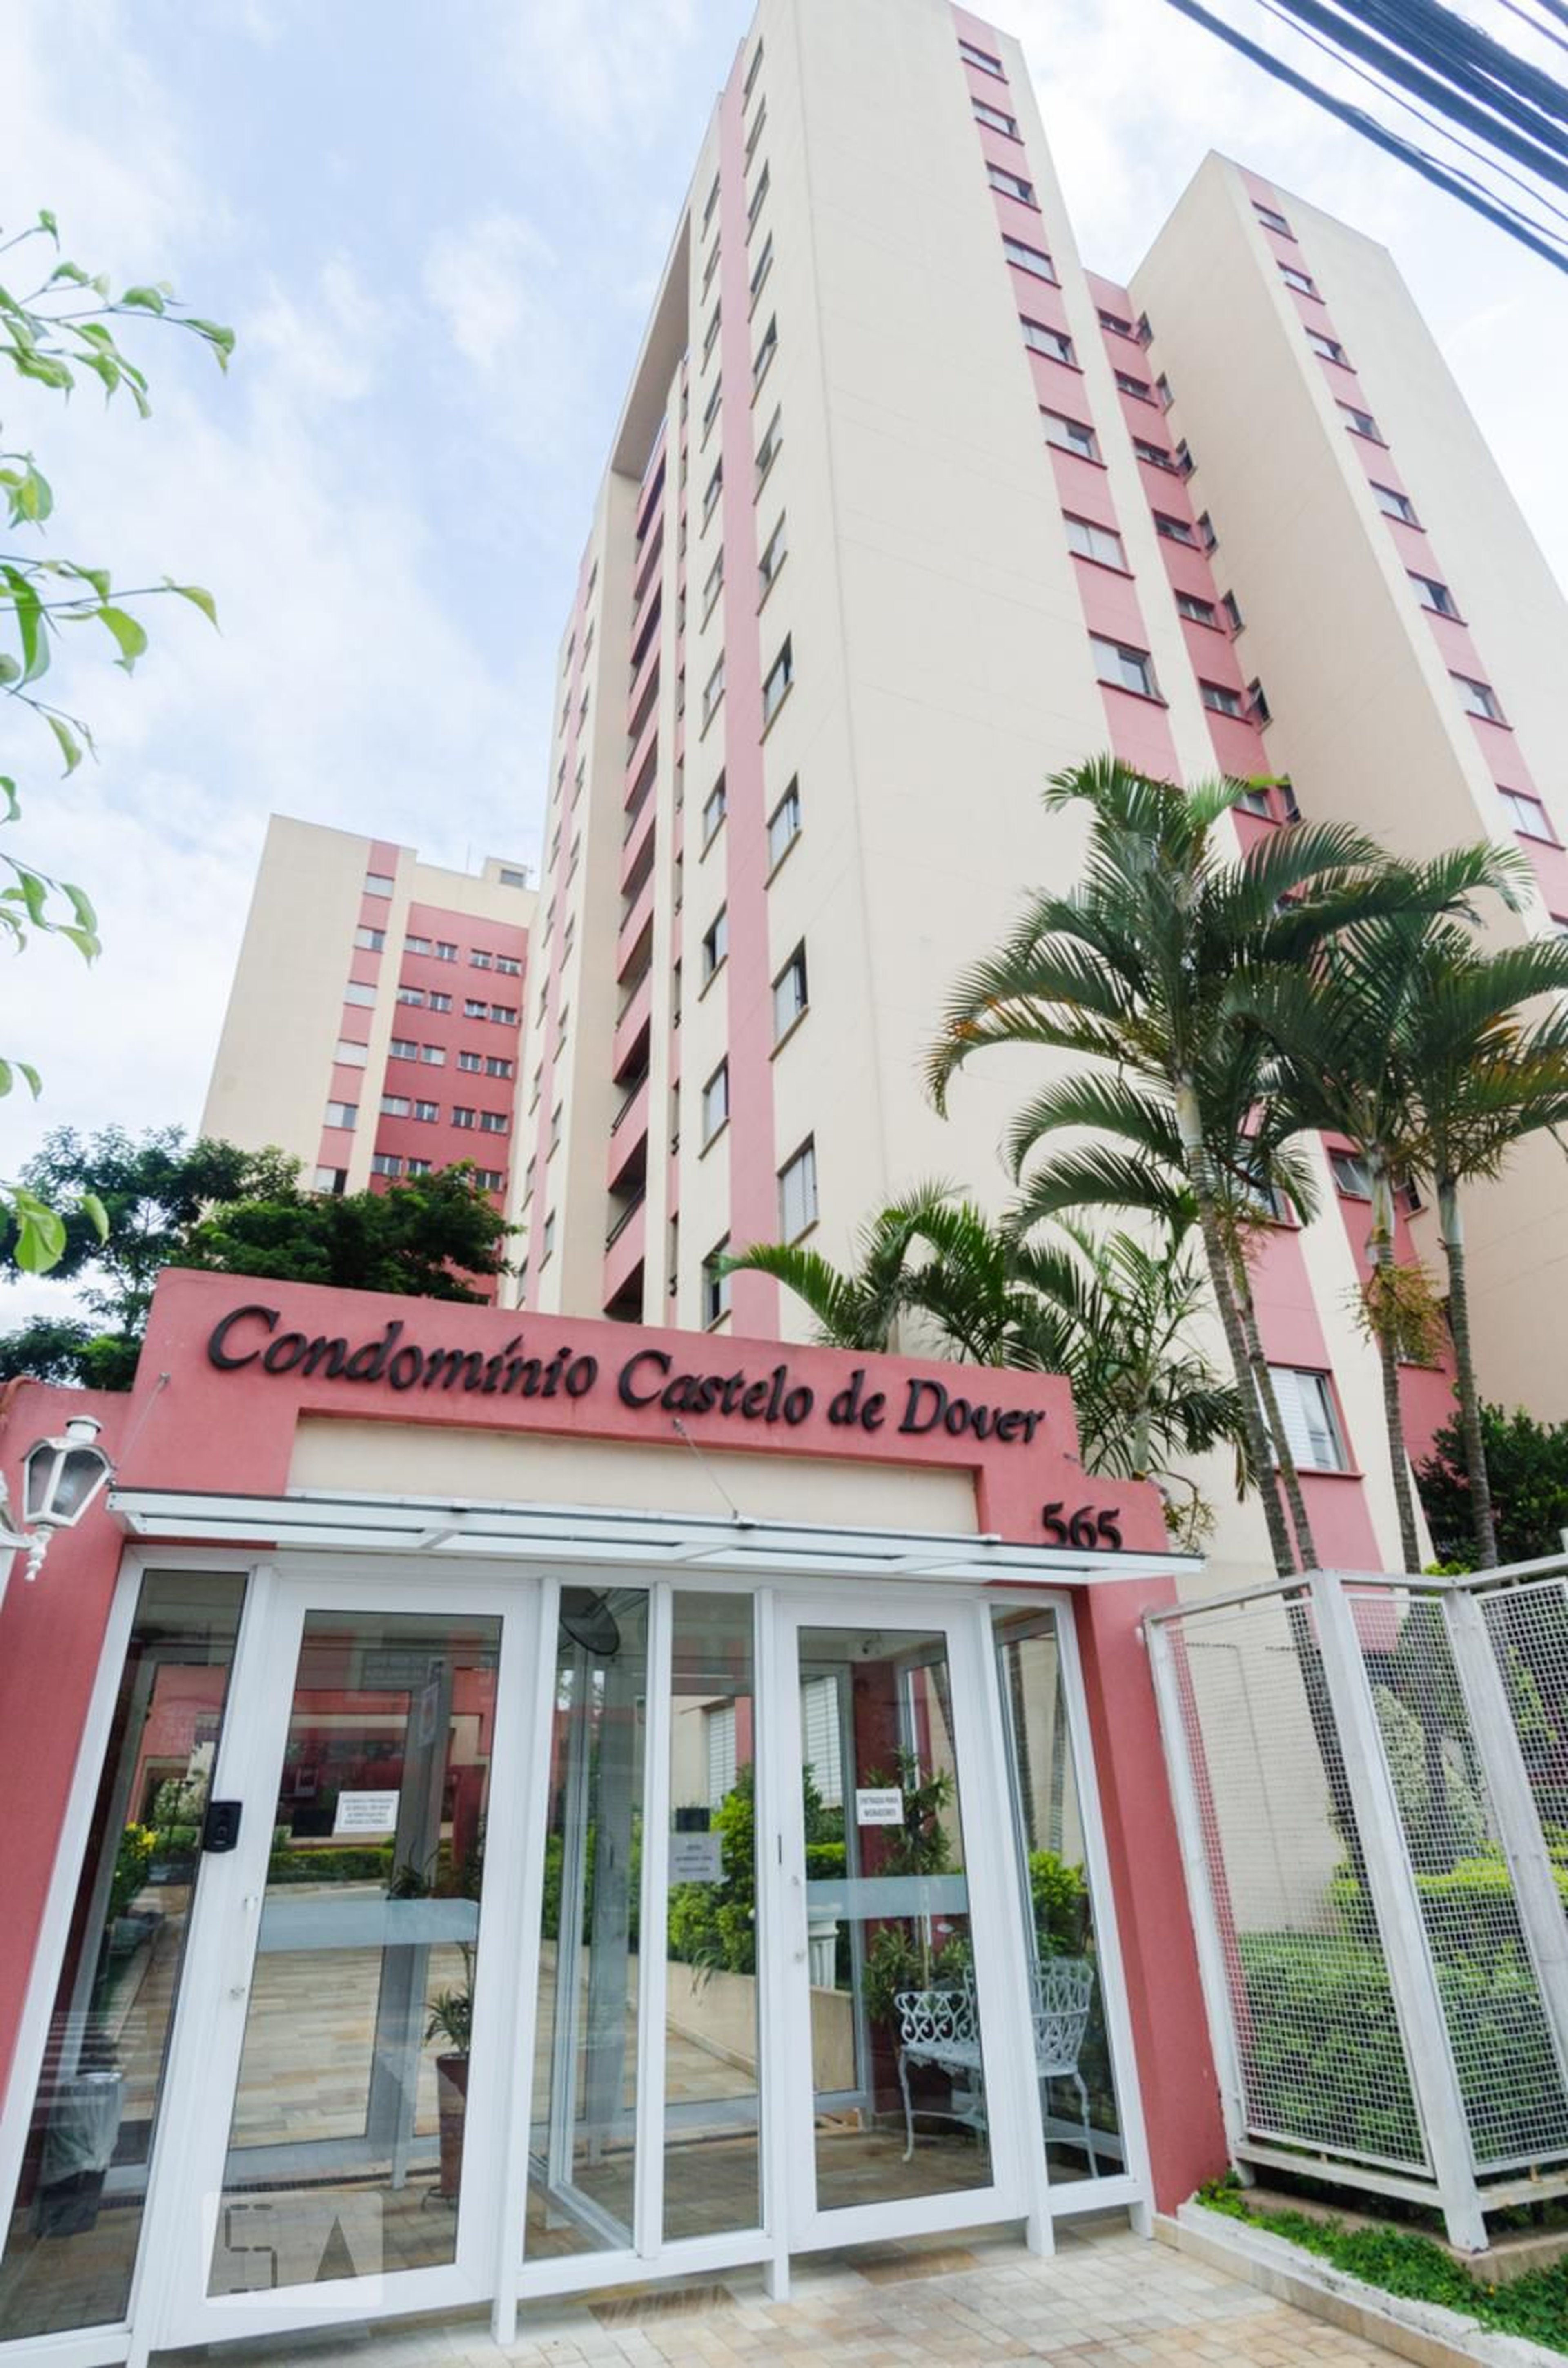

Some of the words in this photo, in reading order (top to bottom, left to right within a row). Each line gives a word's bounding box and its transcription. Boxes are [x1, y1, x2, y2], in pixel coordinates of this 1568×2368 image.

[207, 1305, 598, 1398] Condomínio
[617, 1349, 814, 1427] Castelo
[827, 1369, 886, 1432] de
[898, 1378, 1046, 1444] Dover
[1042, 1501, 1122, 1550] 565
